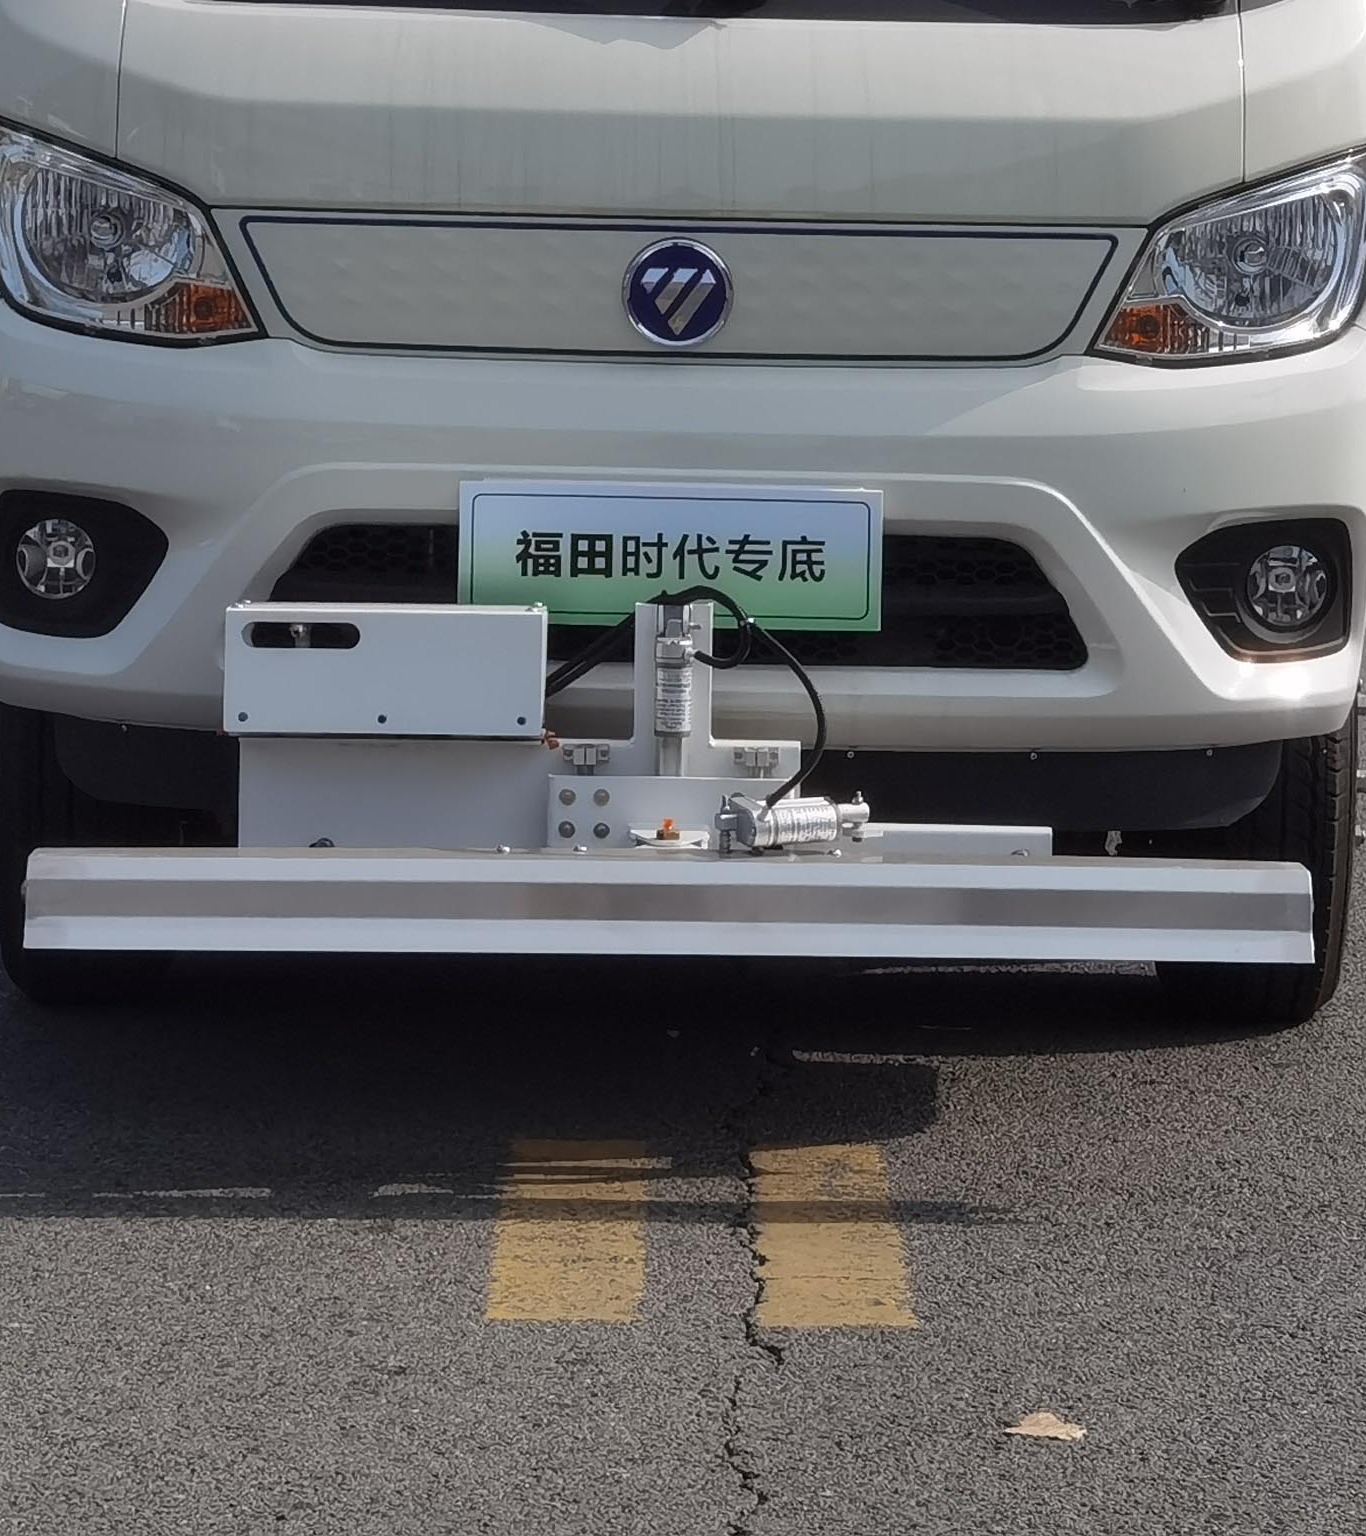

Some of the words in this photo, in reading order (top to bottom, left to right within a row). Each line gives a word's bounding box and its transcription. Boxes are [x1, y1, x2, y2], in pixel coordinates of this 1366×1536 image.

[515, 530, 827, 584] 福田时代专底
